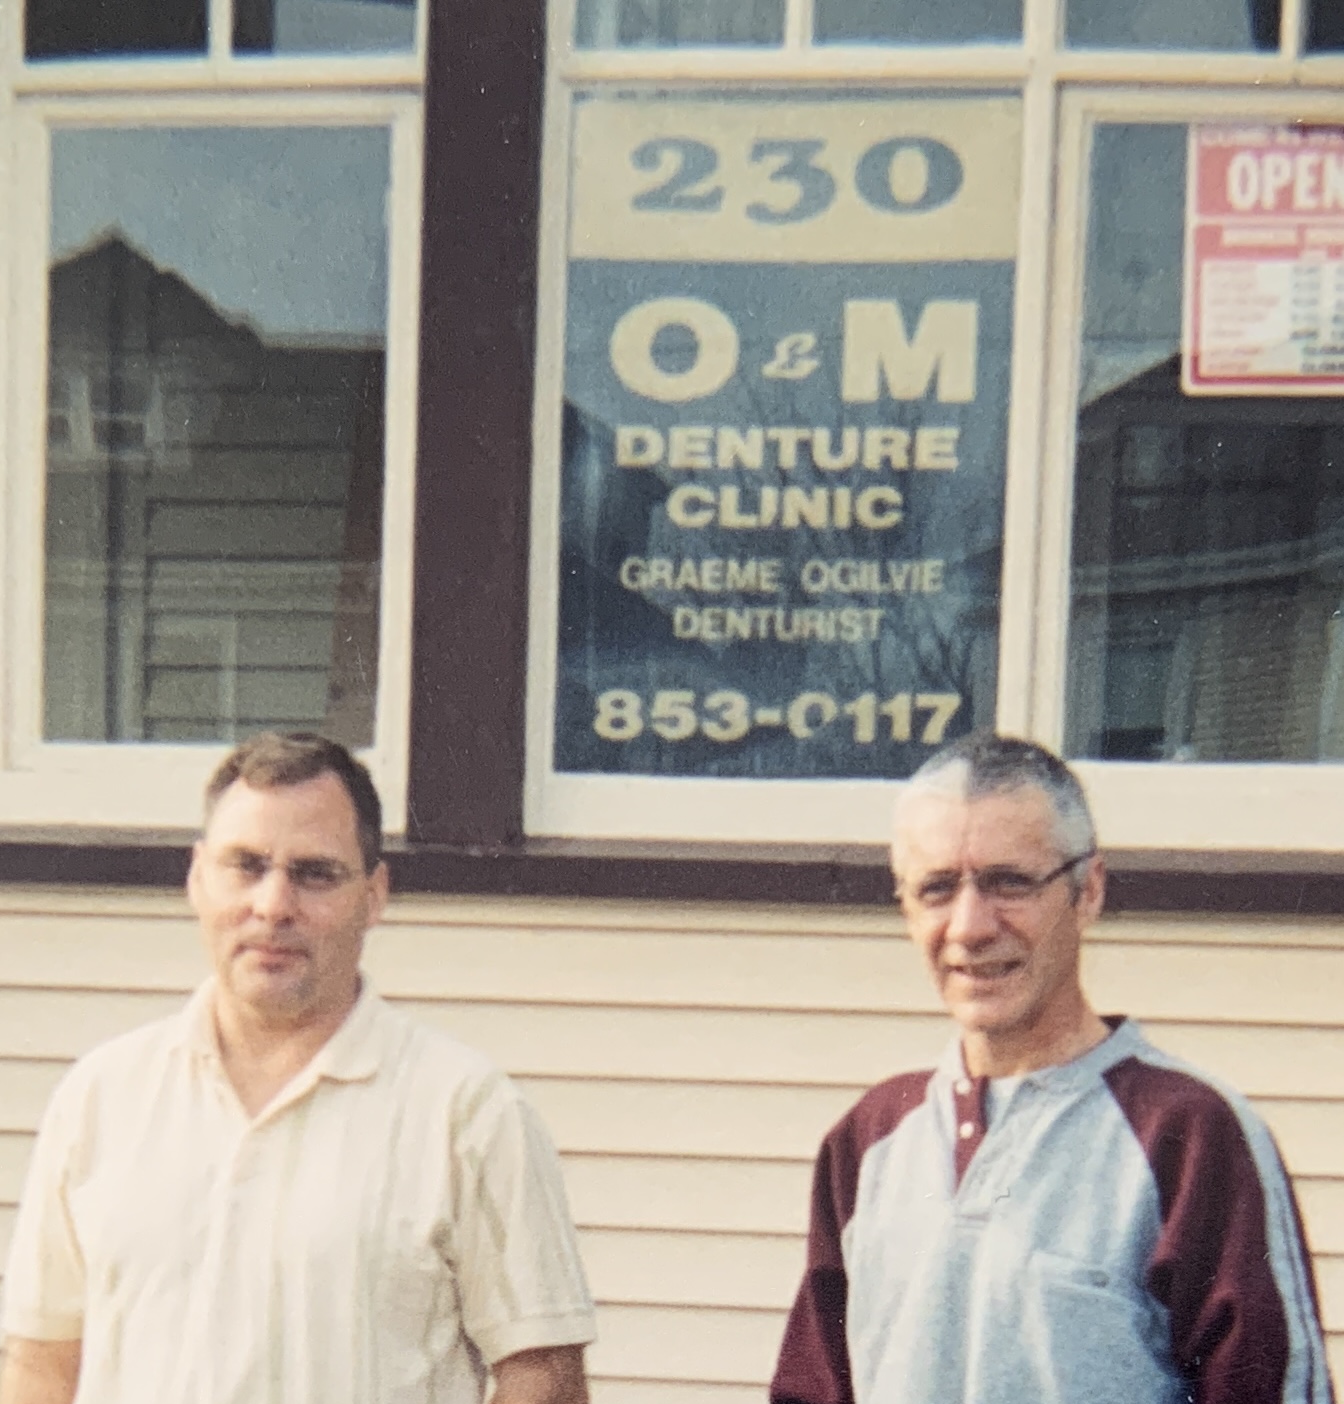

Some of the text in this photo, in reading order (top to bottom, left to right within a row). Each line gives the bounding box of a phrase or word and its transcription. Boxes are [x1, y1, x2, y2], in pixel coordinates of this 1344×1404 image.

[628, 135, 965, 225] 230
[610, 297, 980, 403] O & M
[614, 425, 962, 472] DENTURE
[665, 484, 905, 530] CLINIC
[619, 556, 946, 595] GRAEME OGILVIE
[671, 605, 887, 643] DENTURIST
[592, 689, 963, 746] 853-0117
